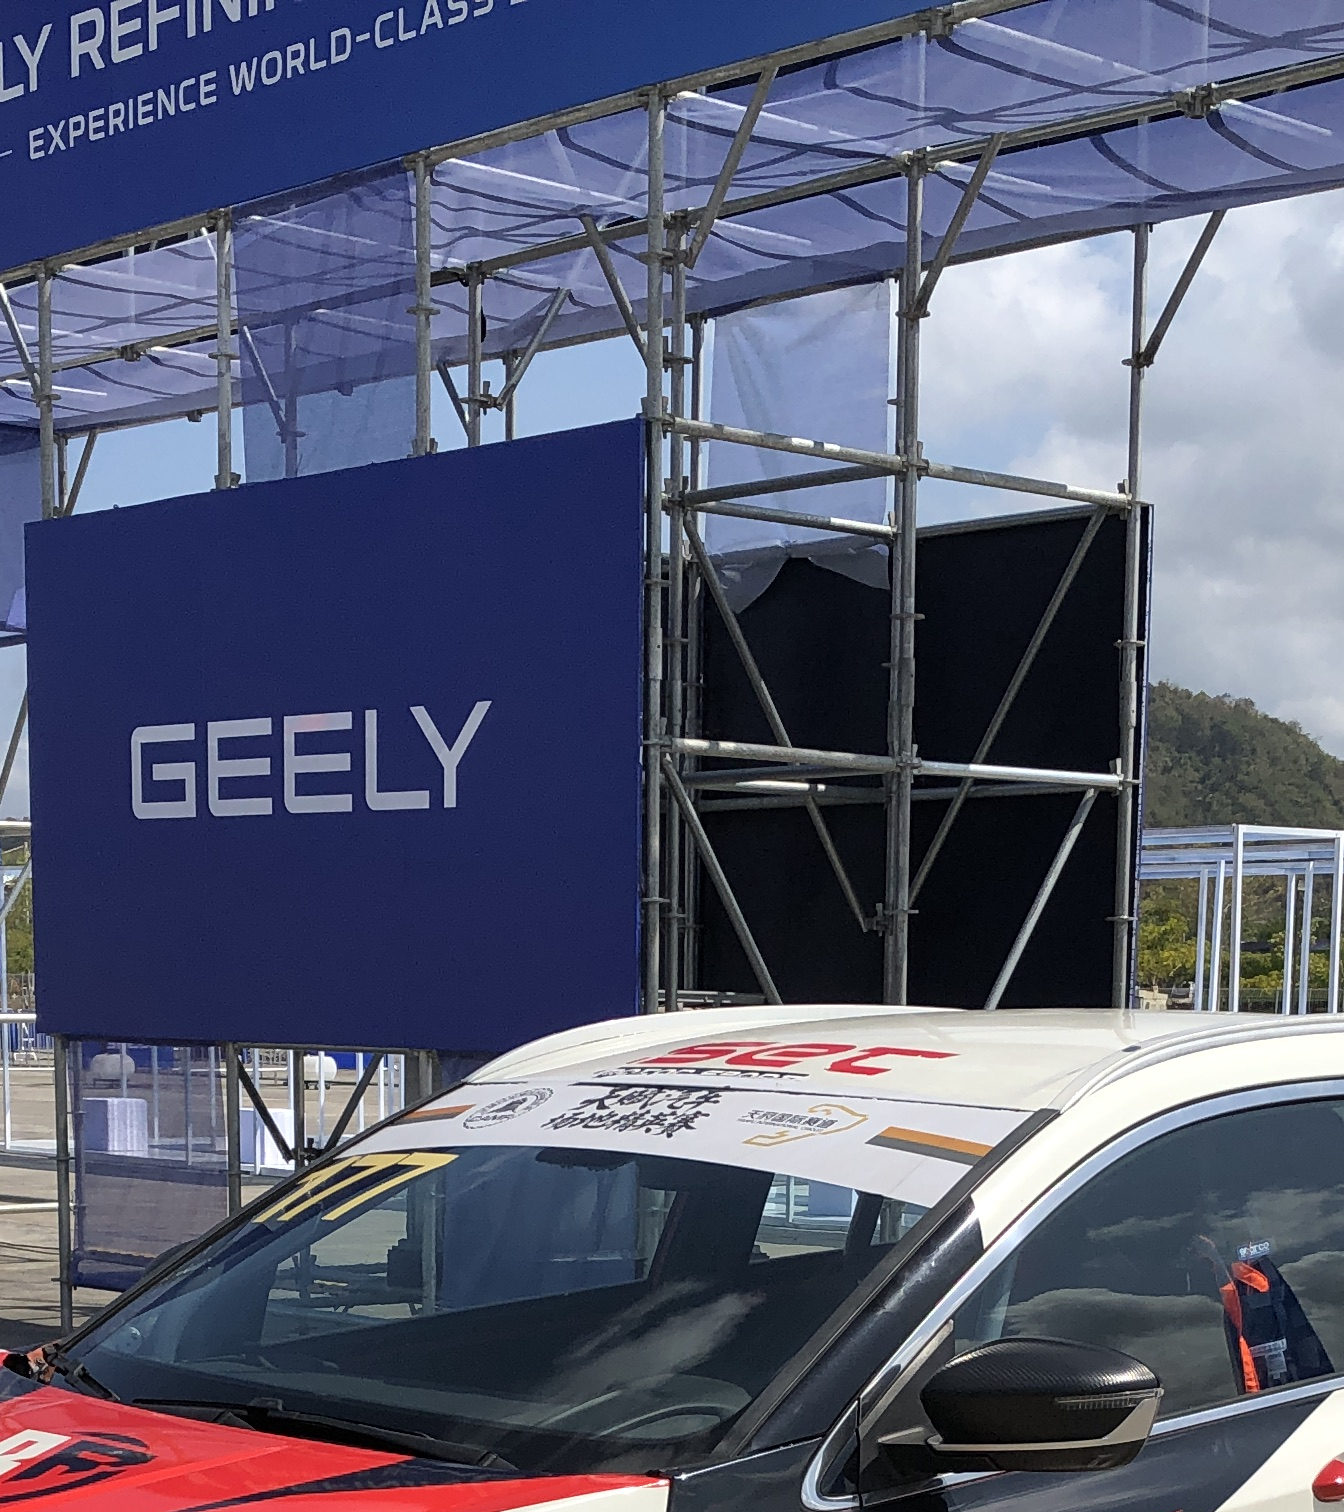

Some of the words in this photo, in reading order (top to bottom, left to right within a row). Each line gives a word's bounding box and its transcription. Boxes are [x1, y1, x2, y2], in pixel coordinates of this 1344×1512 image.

[69, 0, 276, 78] REFIN
[28, 70, 217, 160] EXPERIENCE
[130, 700, 493, 820] GEELY
[252, 1151, 460, 1223] 177
